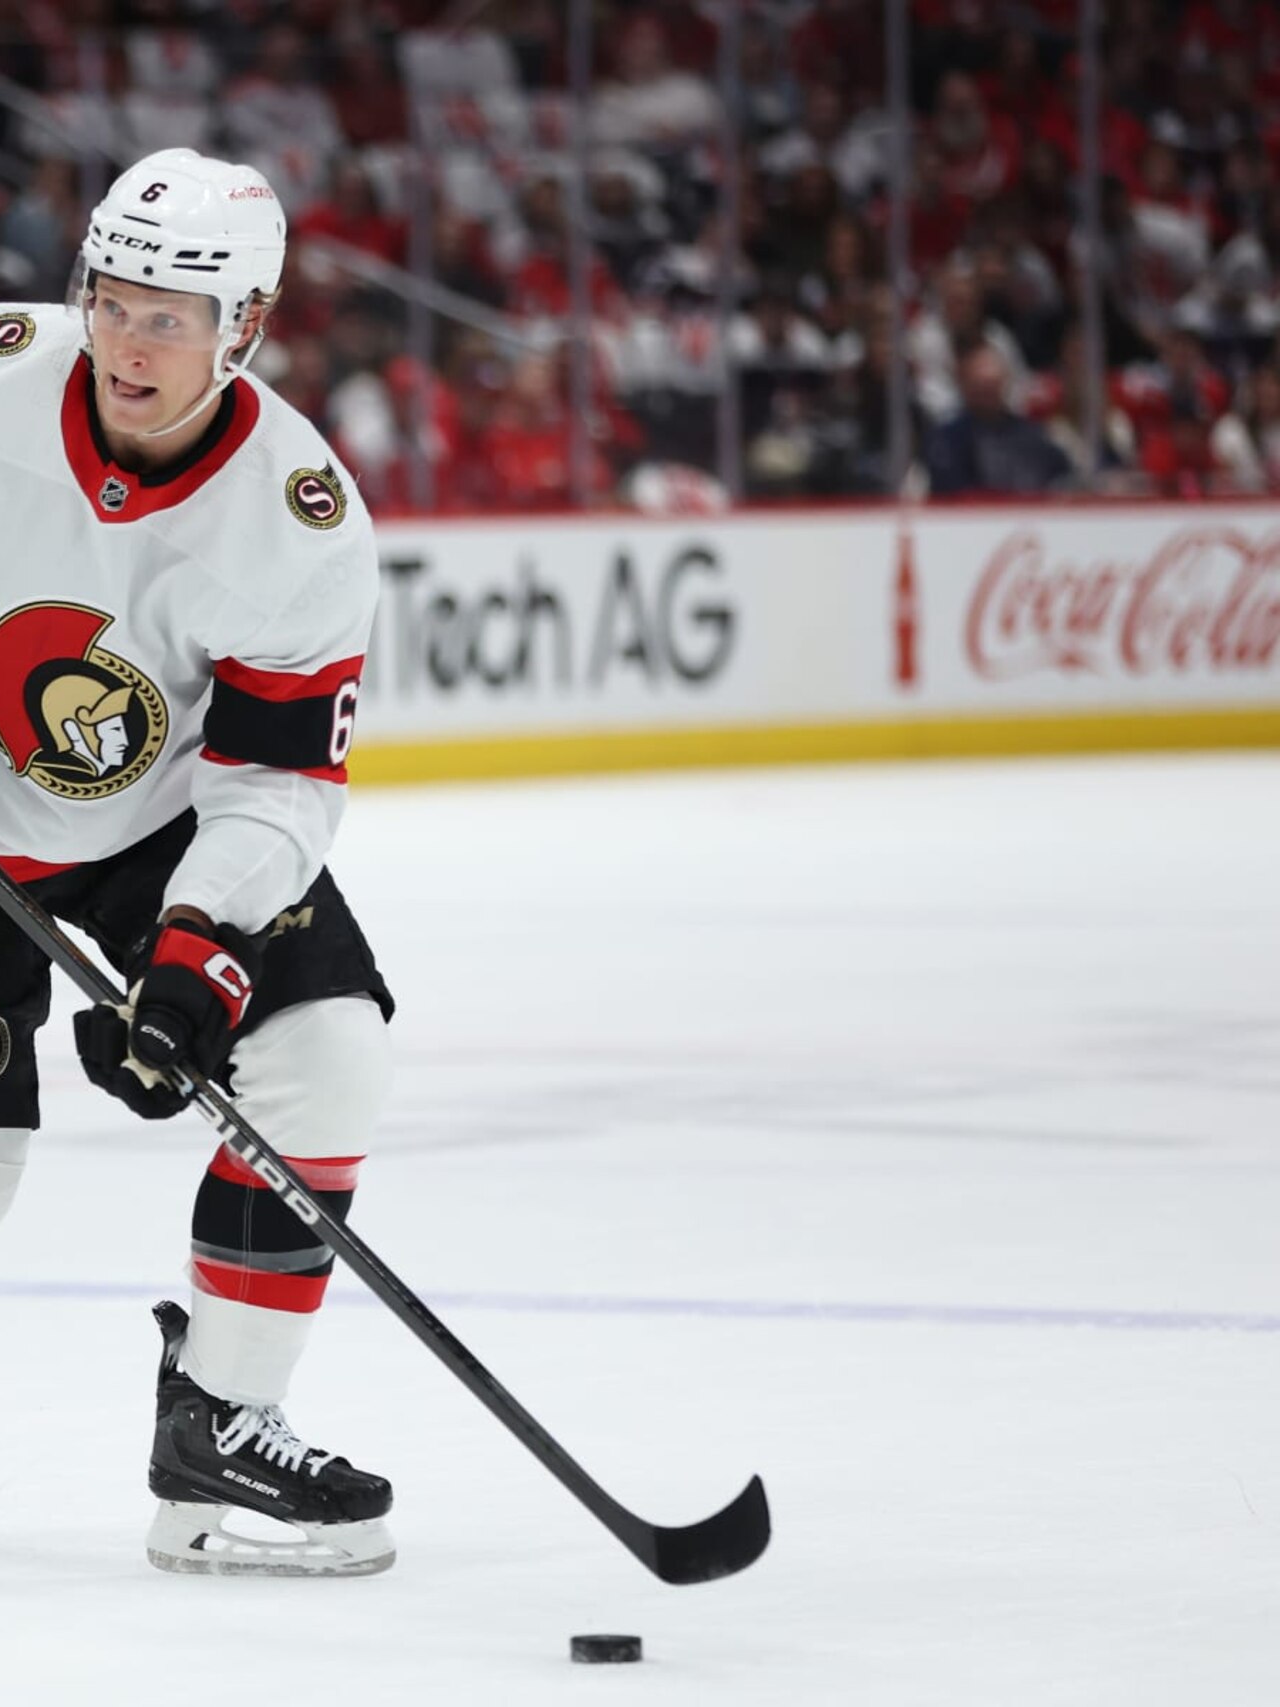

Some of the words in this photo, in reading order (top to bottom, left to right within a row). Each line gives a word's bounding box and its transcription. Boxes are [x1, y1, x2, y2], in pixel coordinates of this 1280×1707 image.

[140, 183, 168, 204] 6
[107, 231, 163, 254] CCM
[297, 478, 336, 519] S
[588, 546, 738, 694] AG
[328, 680, 358, 766] 6
[139, 1014, 177, 1050] CCM
[221, 1468, 281, 1499] BAUER
